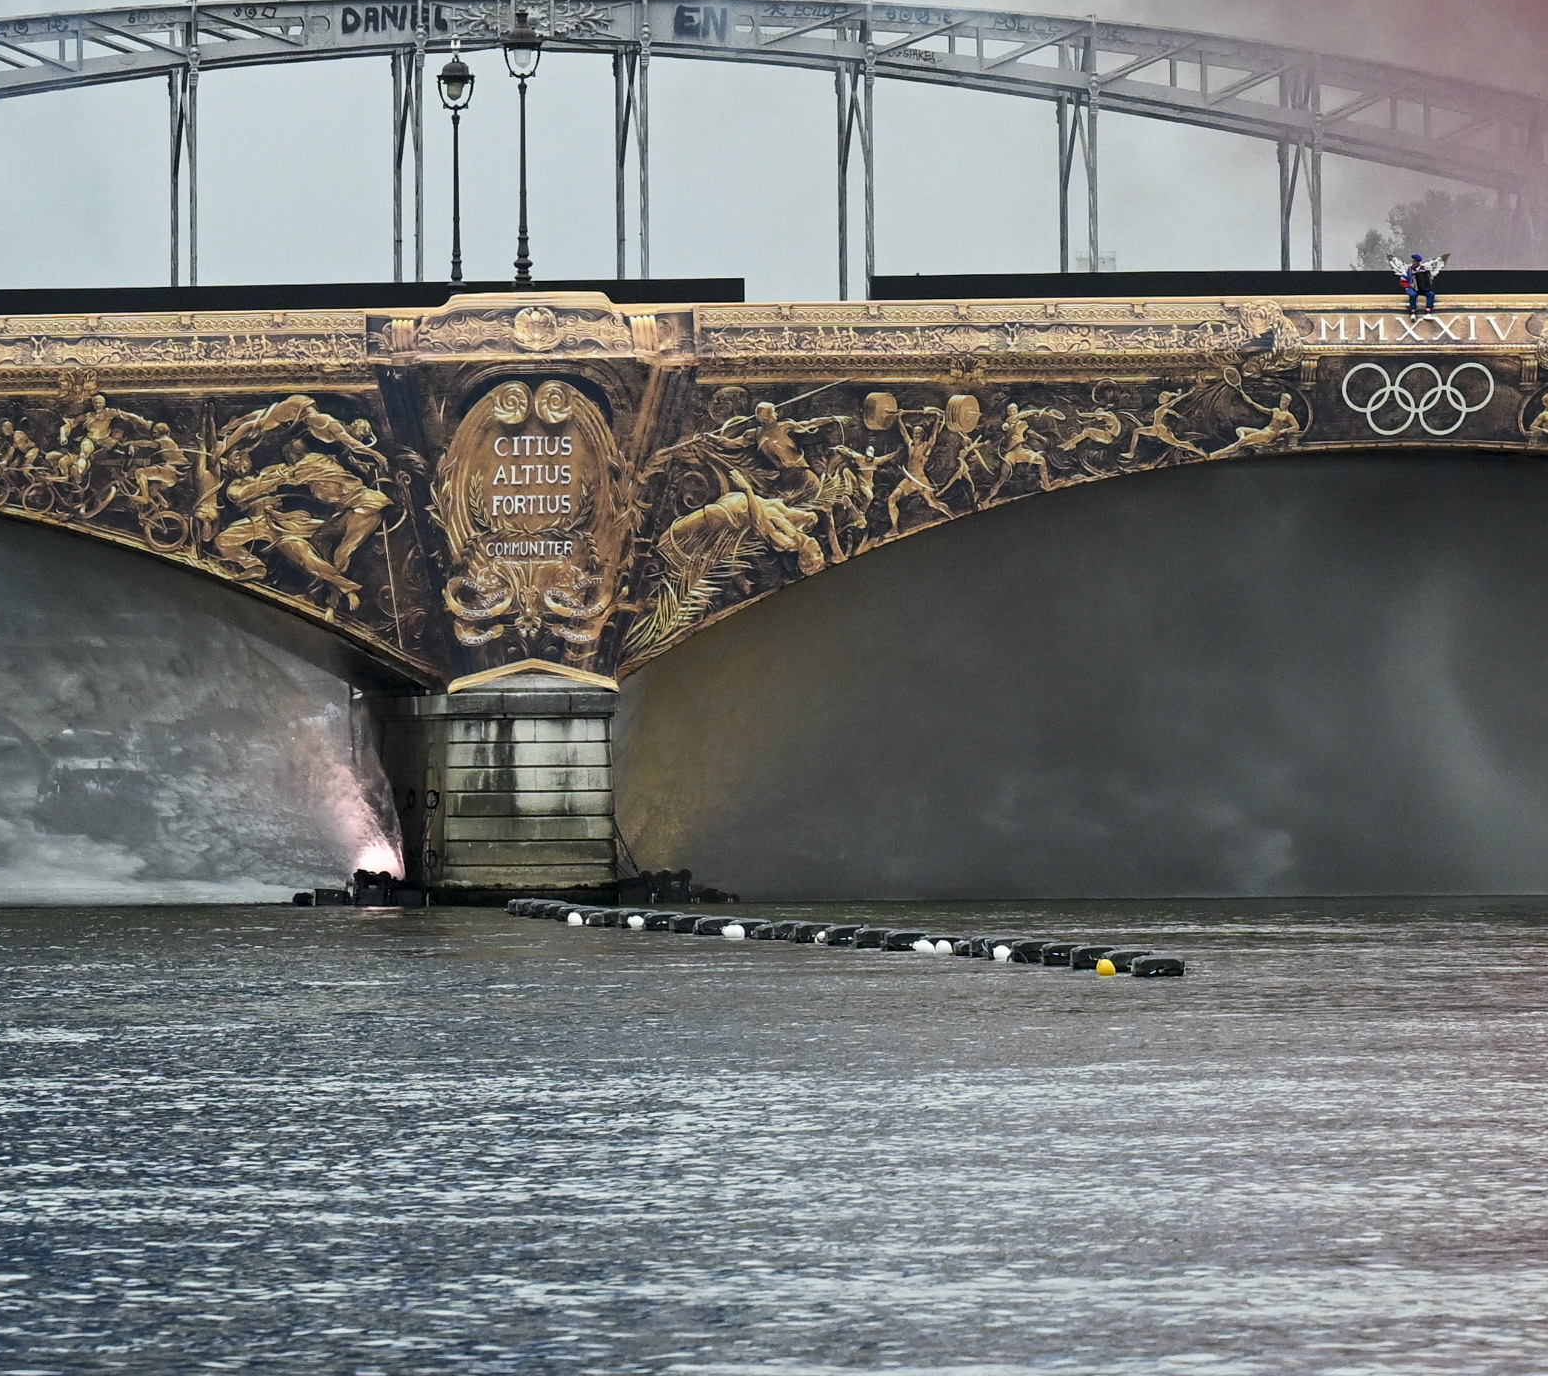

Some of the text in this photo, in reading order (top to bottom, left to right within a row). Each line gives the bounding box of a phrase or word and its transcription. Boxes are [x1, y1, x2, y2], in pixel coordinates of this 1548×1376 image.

[341, 5, 448, 34] DANIEL
[673, 4, 728, 44] EN
[1318, 315, 1518, 342] MMXXIV
[494, 436, 572, 456] CITIUS
[493, 465, 571, 485] ALTIUS
[492, 495, 571, 516] FORTIUS
[486, 541, 573, 556] COMMUNITER
[461, 578, 486, 593] FASTER
[587, 576, 604, 586] VITE
